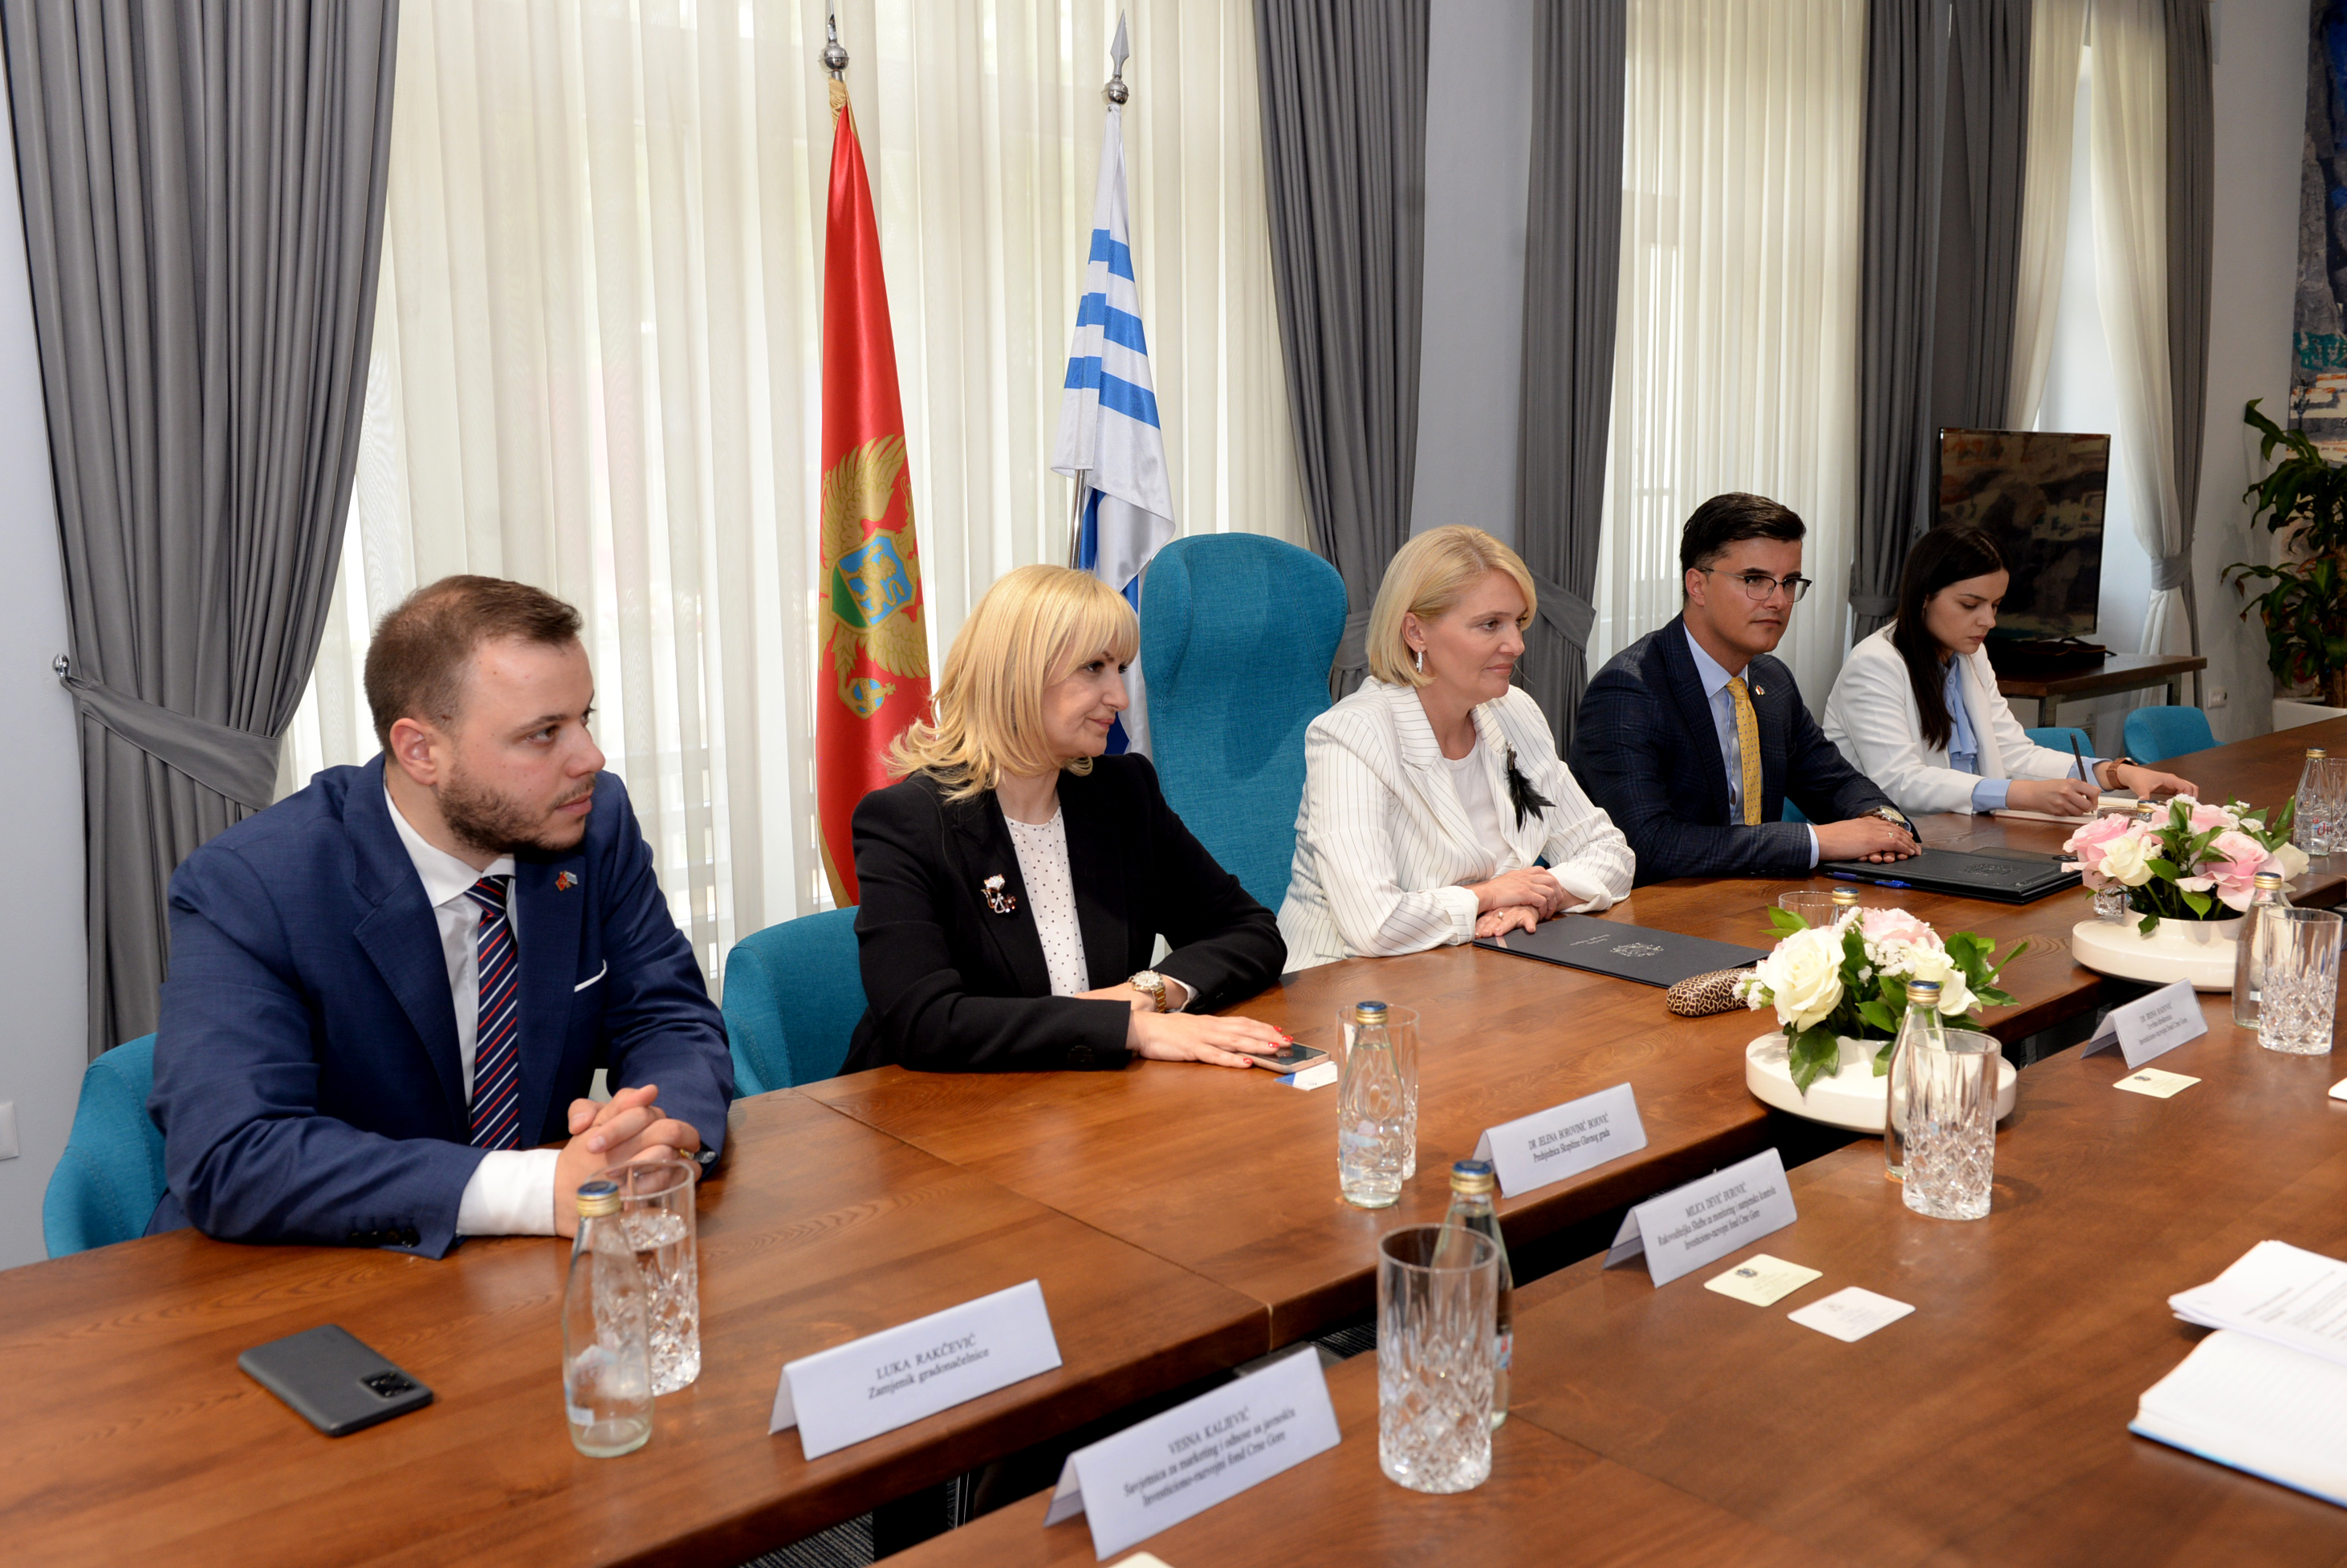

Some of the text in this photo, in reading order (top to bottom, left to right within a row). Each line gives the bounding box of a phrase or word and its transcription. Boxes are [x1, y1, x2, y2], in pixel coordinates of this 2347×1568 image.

[1527, 1139, 1536, 1150] DR
[1538, 1132, 1557, 1146] JELENA
[877, 1333, 976, 1379] LUKA RAKČEVIĆ
[868, 1374, 915, 1399] Zamjenik
[1168, 1432, 1201, 1453] VESNA
[1178, 1445, 1218, 1469] marketing
